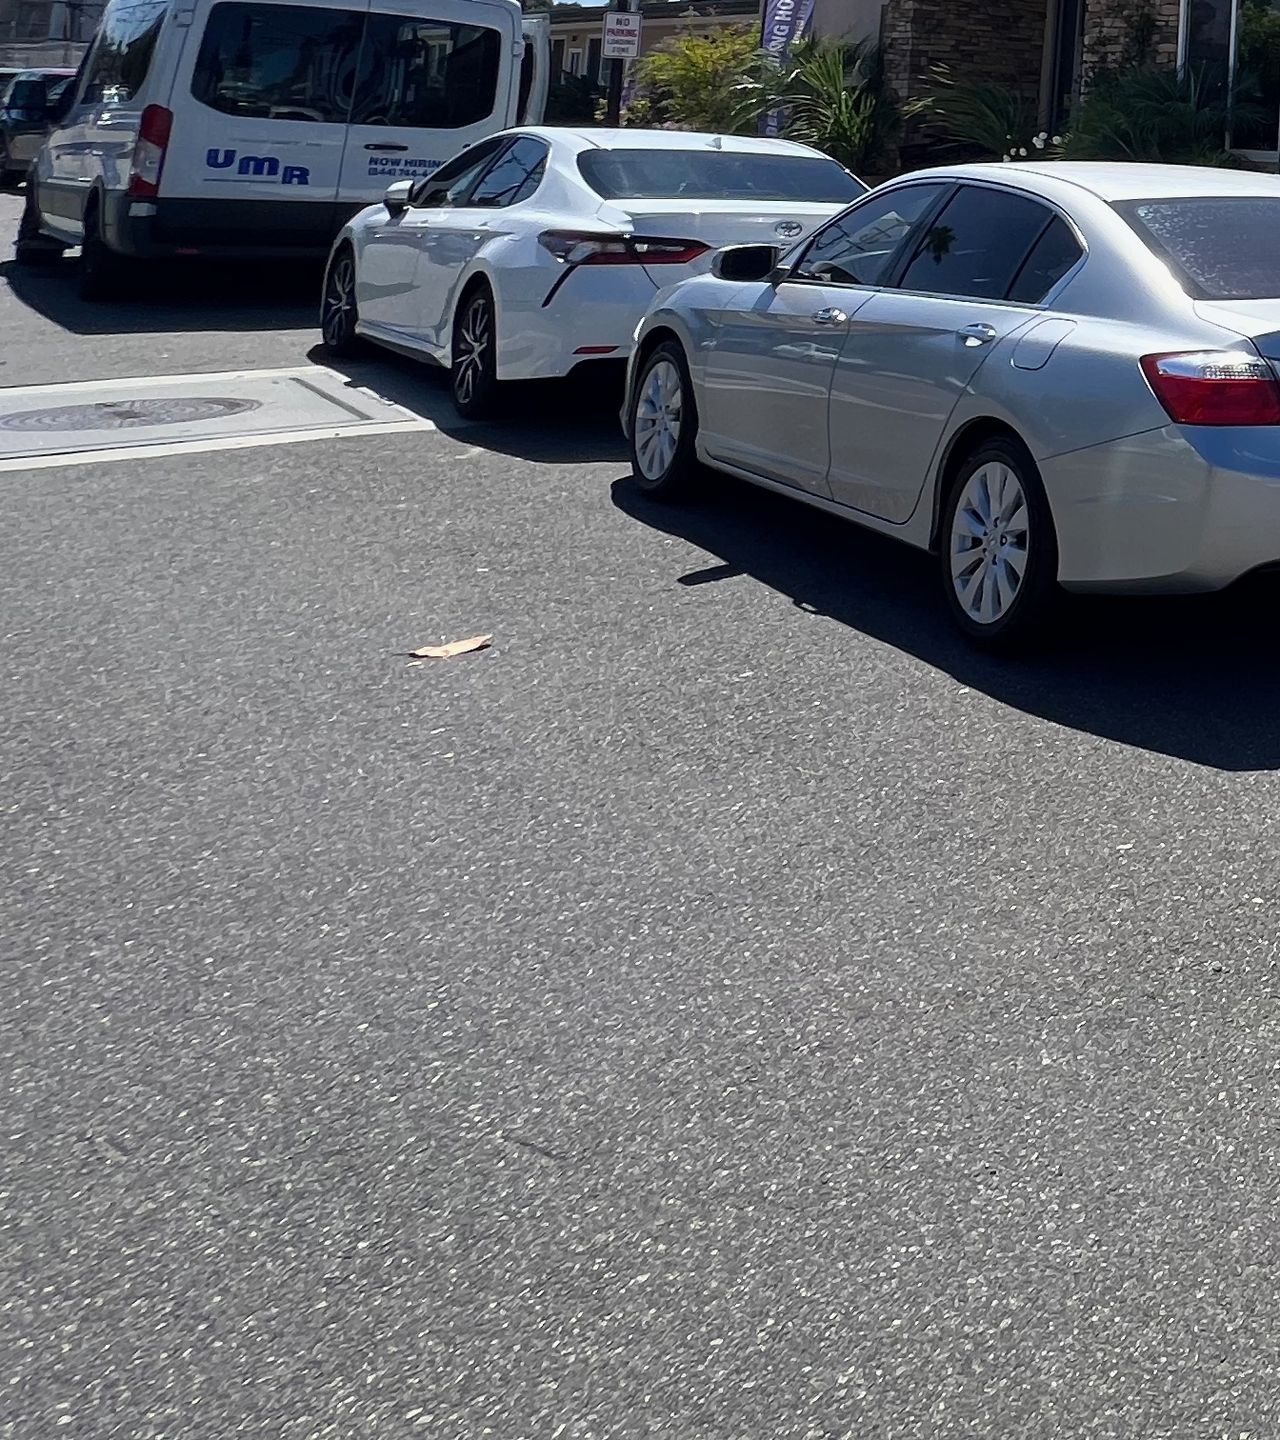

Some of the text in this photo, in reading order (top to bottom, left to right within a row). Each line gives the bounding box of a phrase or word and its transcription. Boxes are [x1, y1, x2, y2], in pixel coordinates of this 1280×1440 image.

[616, 18, 630, 26] NO
[607, 28, 637, 37] PARKING
[368, 156, 402, 167] NOW
